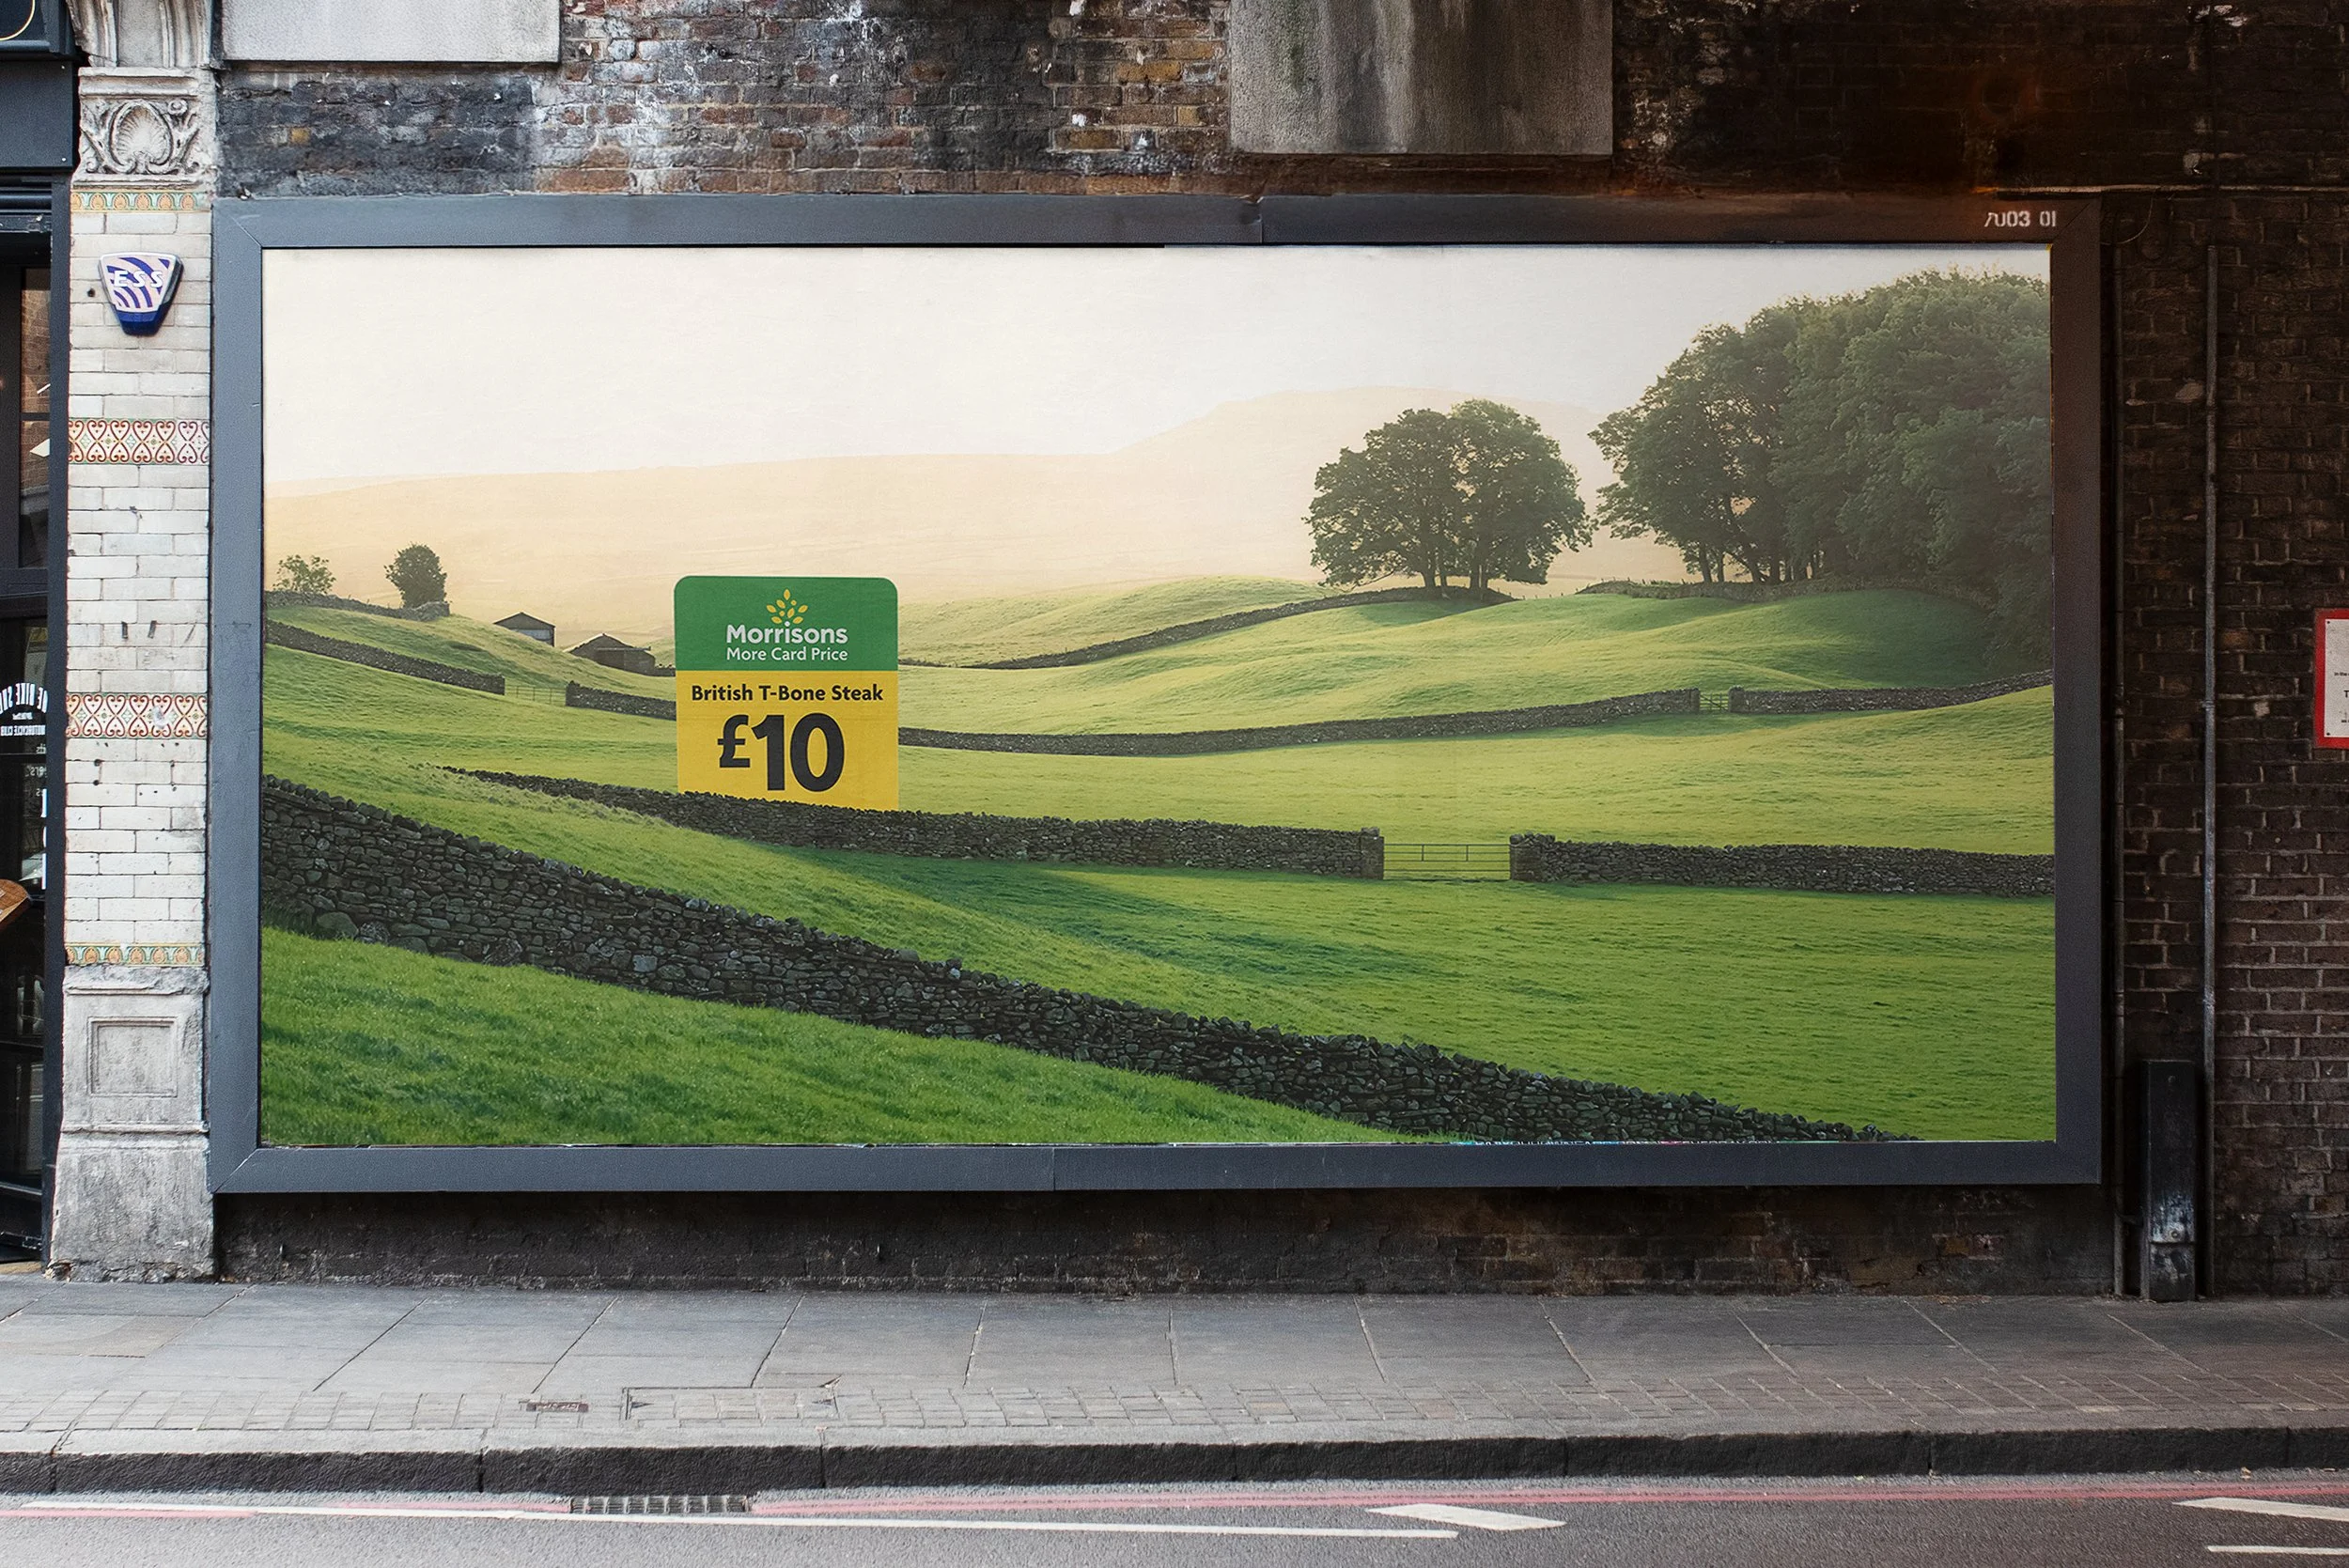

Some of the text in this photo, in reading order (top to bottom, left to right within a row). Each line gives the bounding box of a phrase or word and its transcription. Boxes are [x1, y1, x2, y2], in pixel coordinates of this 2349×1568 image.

[114, 270, 163, 287] ESS
[725, 621, 848, 644] Morrisons
[726, 646, 848, 660] More Card Price
[692, 684, 883, 701] British T-Bone Steak
[717, 712, 845, 792] £10
